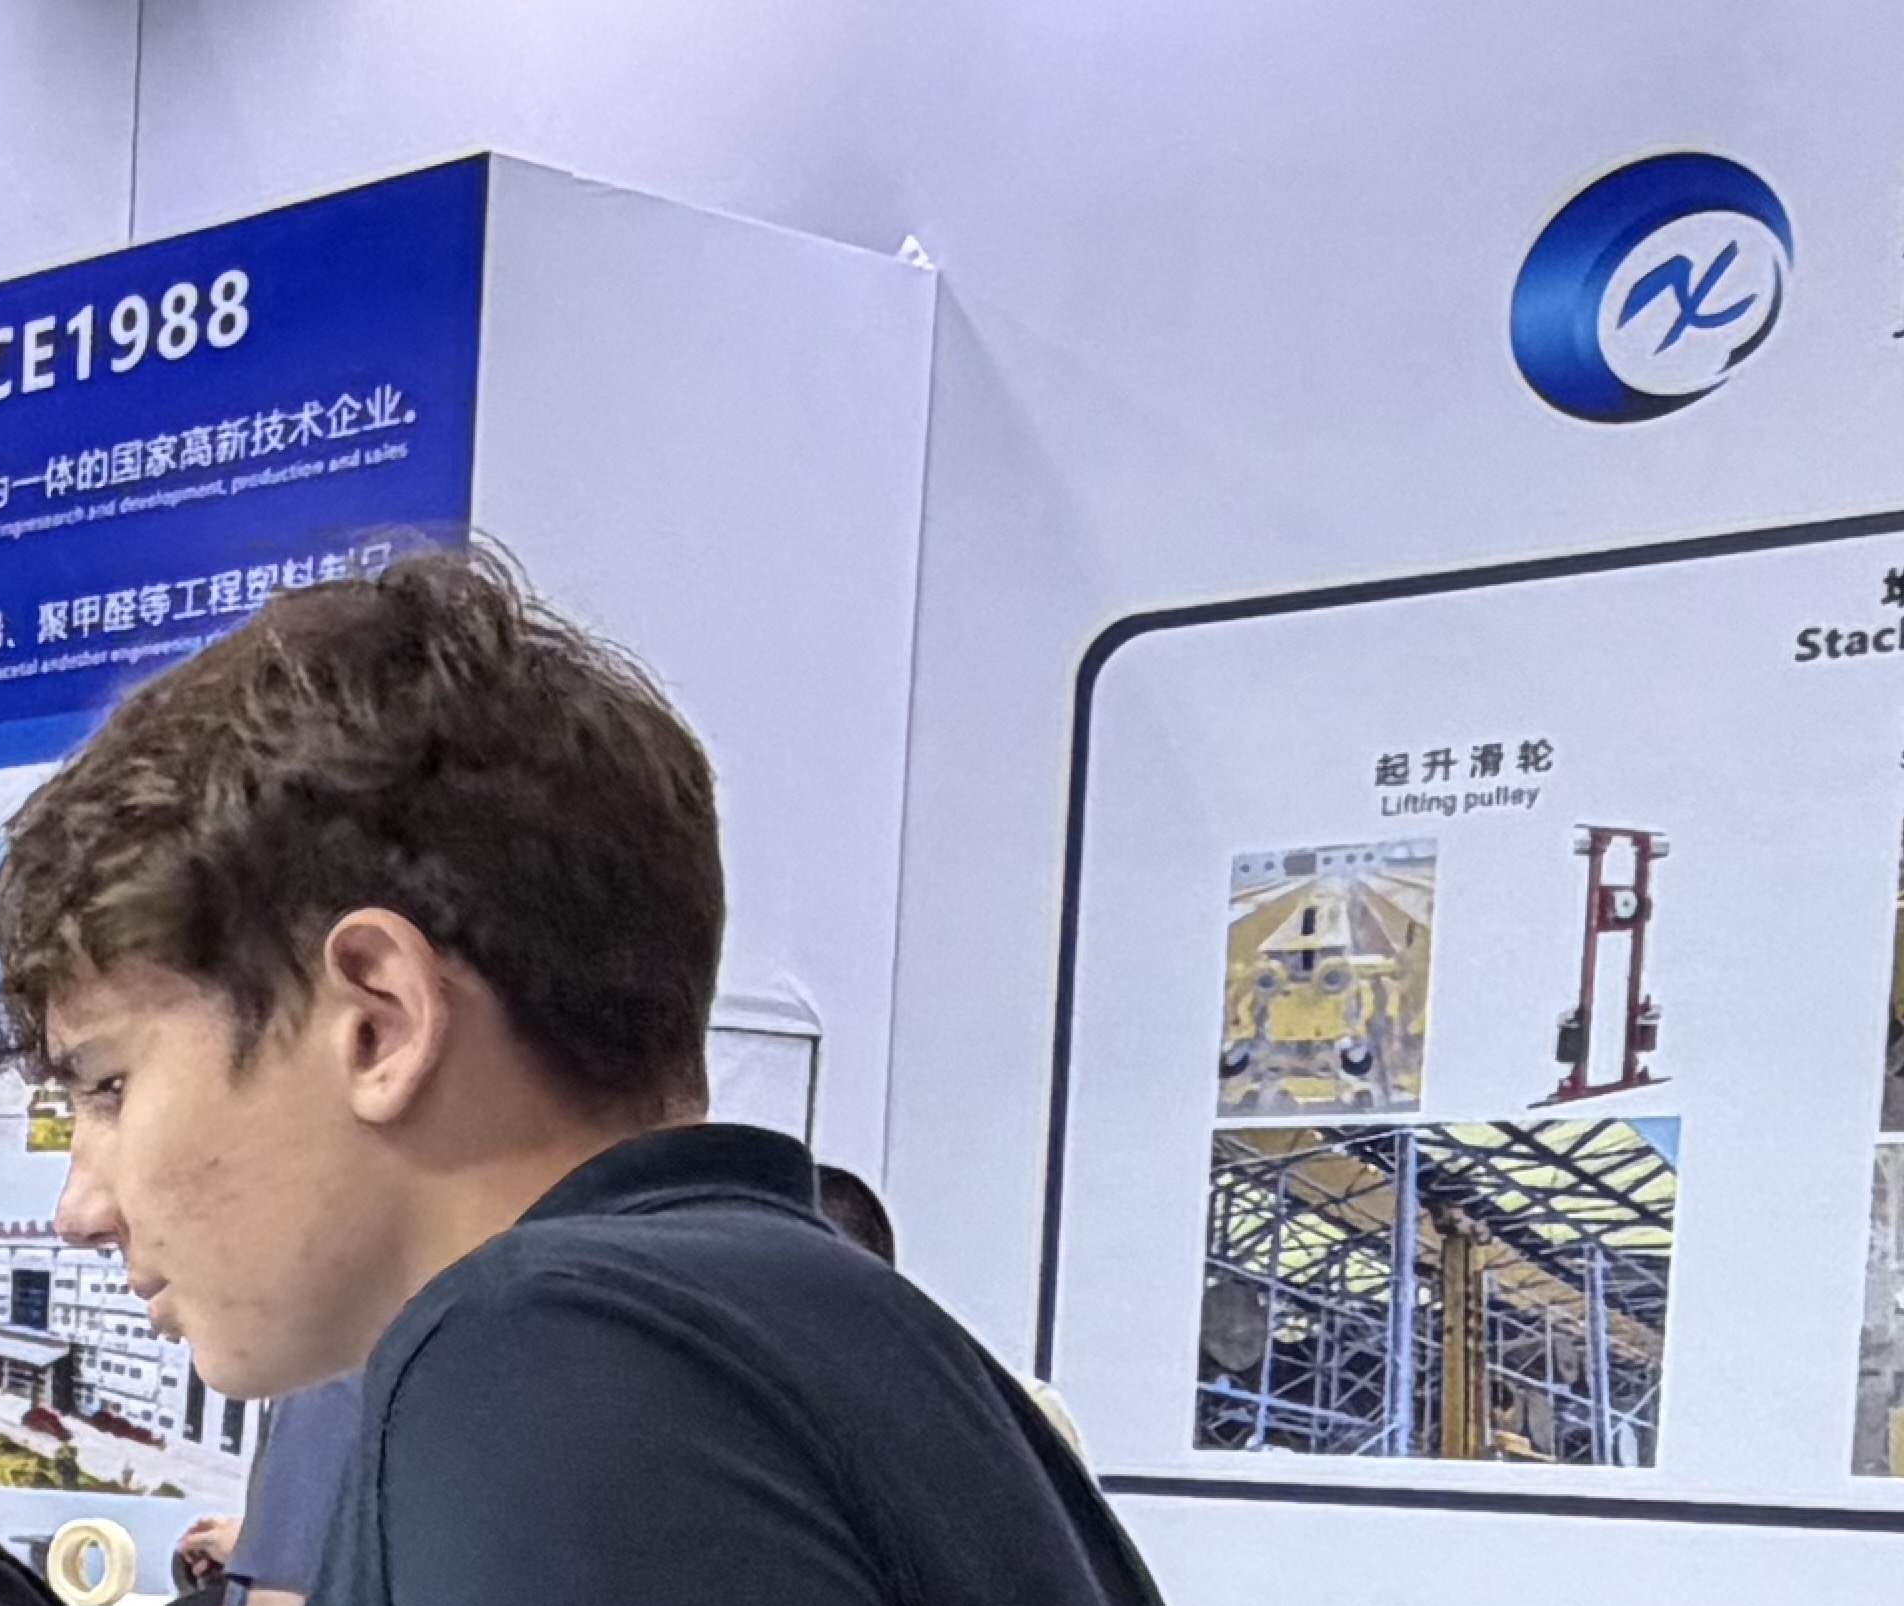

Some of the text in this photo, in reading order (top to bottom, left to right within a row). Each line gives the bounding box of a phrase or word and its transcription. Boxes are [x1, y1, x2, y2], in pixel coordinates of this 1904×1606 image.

[231, 458, 324, 493] production
[329, 450, 360, 472] and
[1795, 616, 1904, 662] Stac
[1375, 738, 1554, 786] 起升滑轮
[1381, 786, 1540, 816] Lifting pulley
